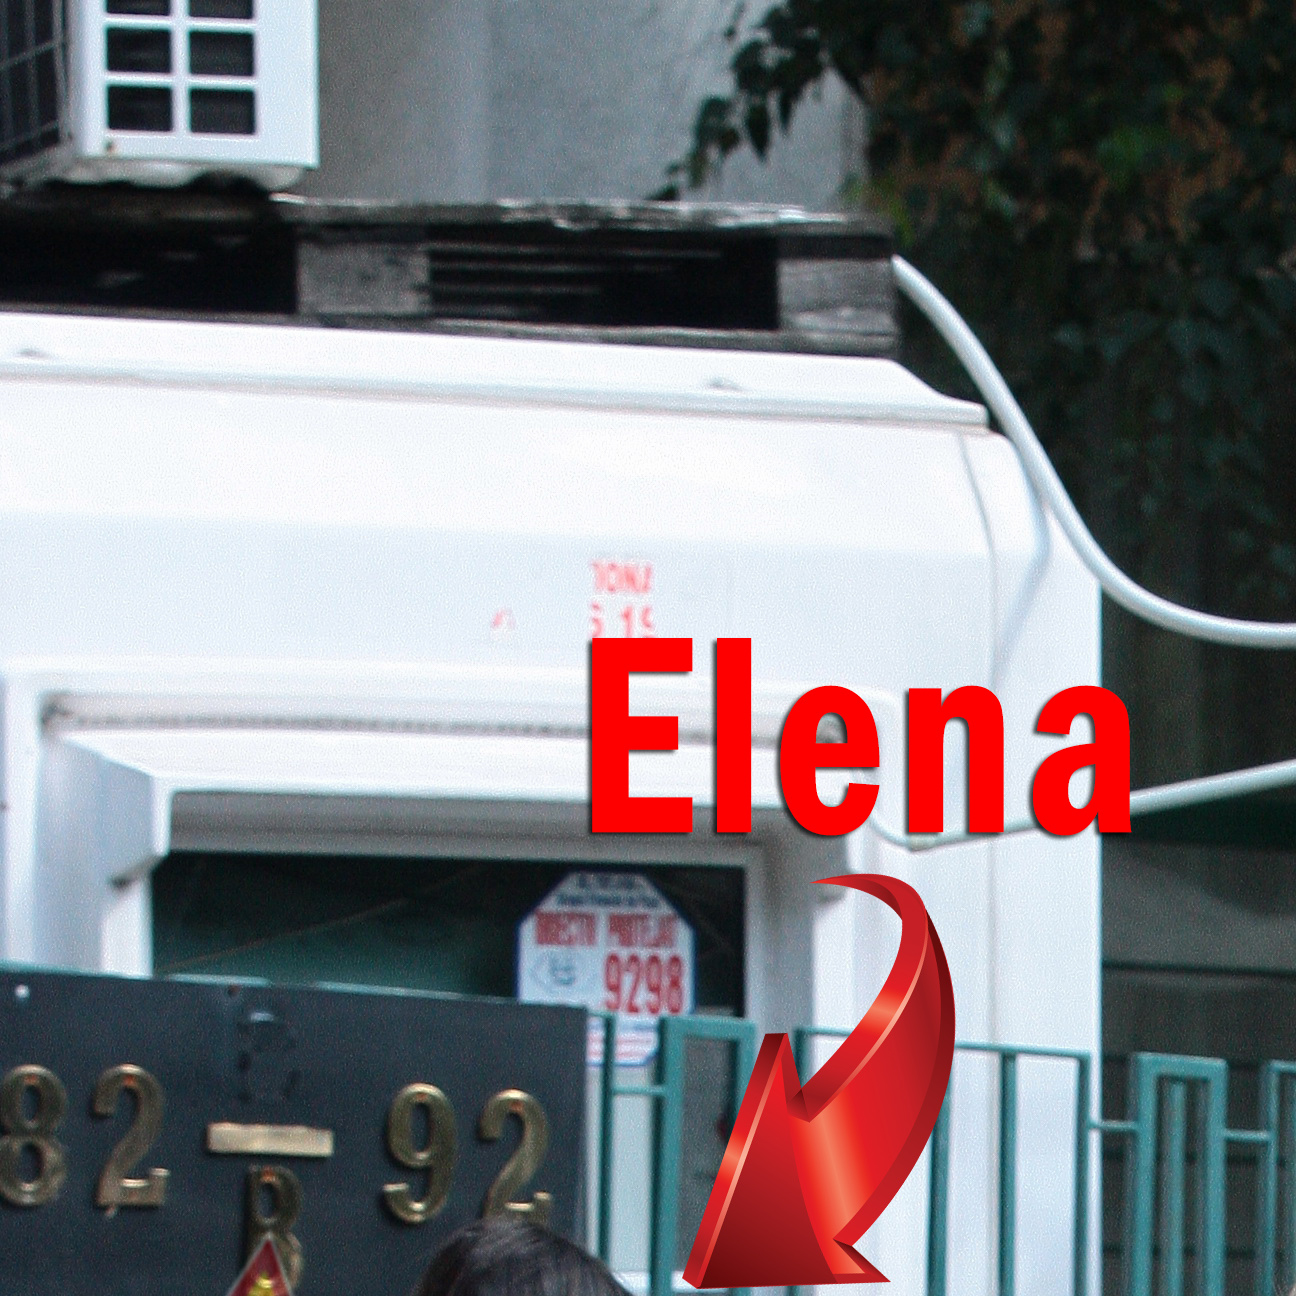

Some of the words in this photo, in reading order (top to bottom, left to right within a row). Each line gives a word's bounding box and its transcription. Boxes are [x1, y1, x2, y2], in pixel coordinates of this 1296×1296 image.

[604, 953, 683, 1015] 9298
[0, 1063, 170, 1218] 82
[382, 1082, 553, 1225] 92
